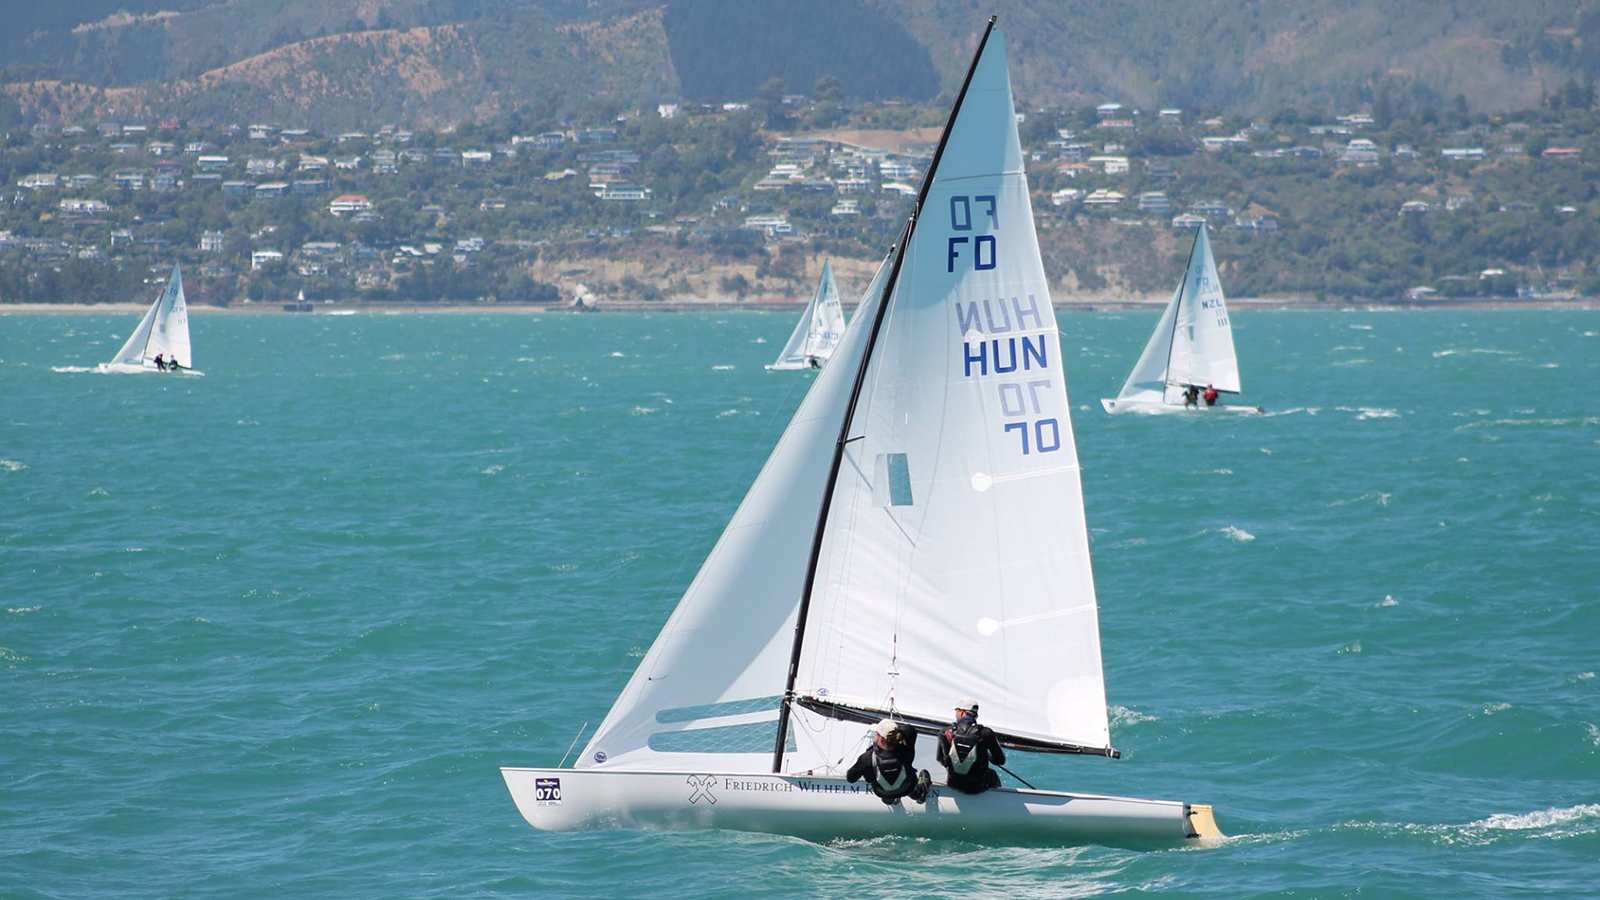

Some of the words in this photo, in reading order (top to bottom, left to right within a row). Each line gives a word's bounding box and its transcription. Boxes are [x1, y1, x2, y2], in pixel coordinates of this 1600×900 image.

[947, 235, 997, 273] FD
[1201, 298, 1222, 309] NZL
[1217, 318, 1228, 327] 111
[963, 334, 1048, 377] HUN
[1004, 417, 1061, 455] 70
[536, 788, 561, 800] 070
[725, 778, 793, 793] FRIEDRICH
[798, 780, 860, 795] WILHELM
